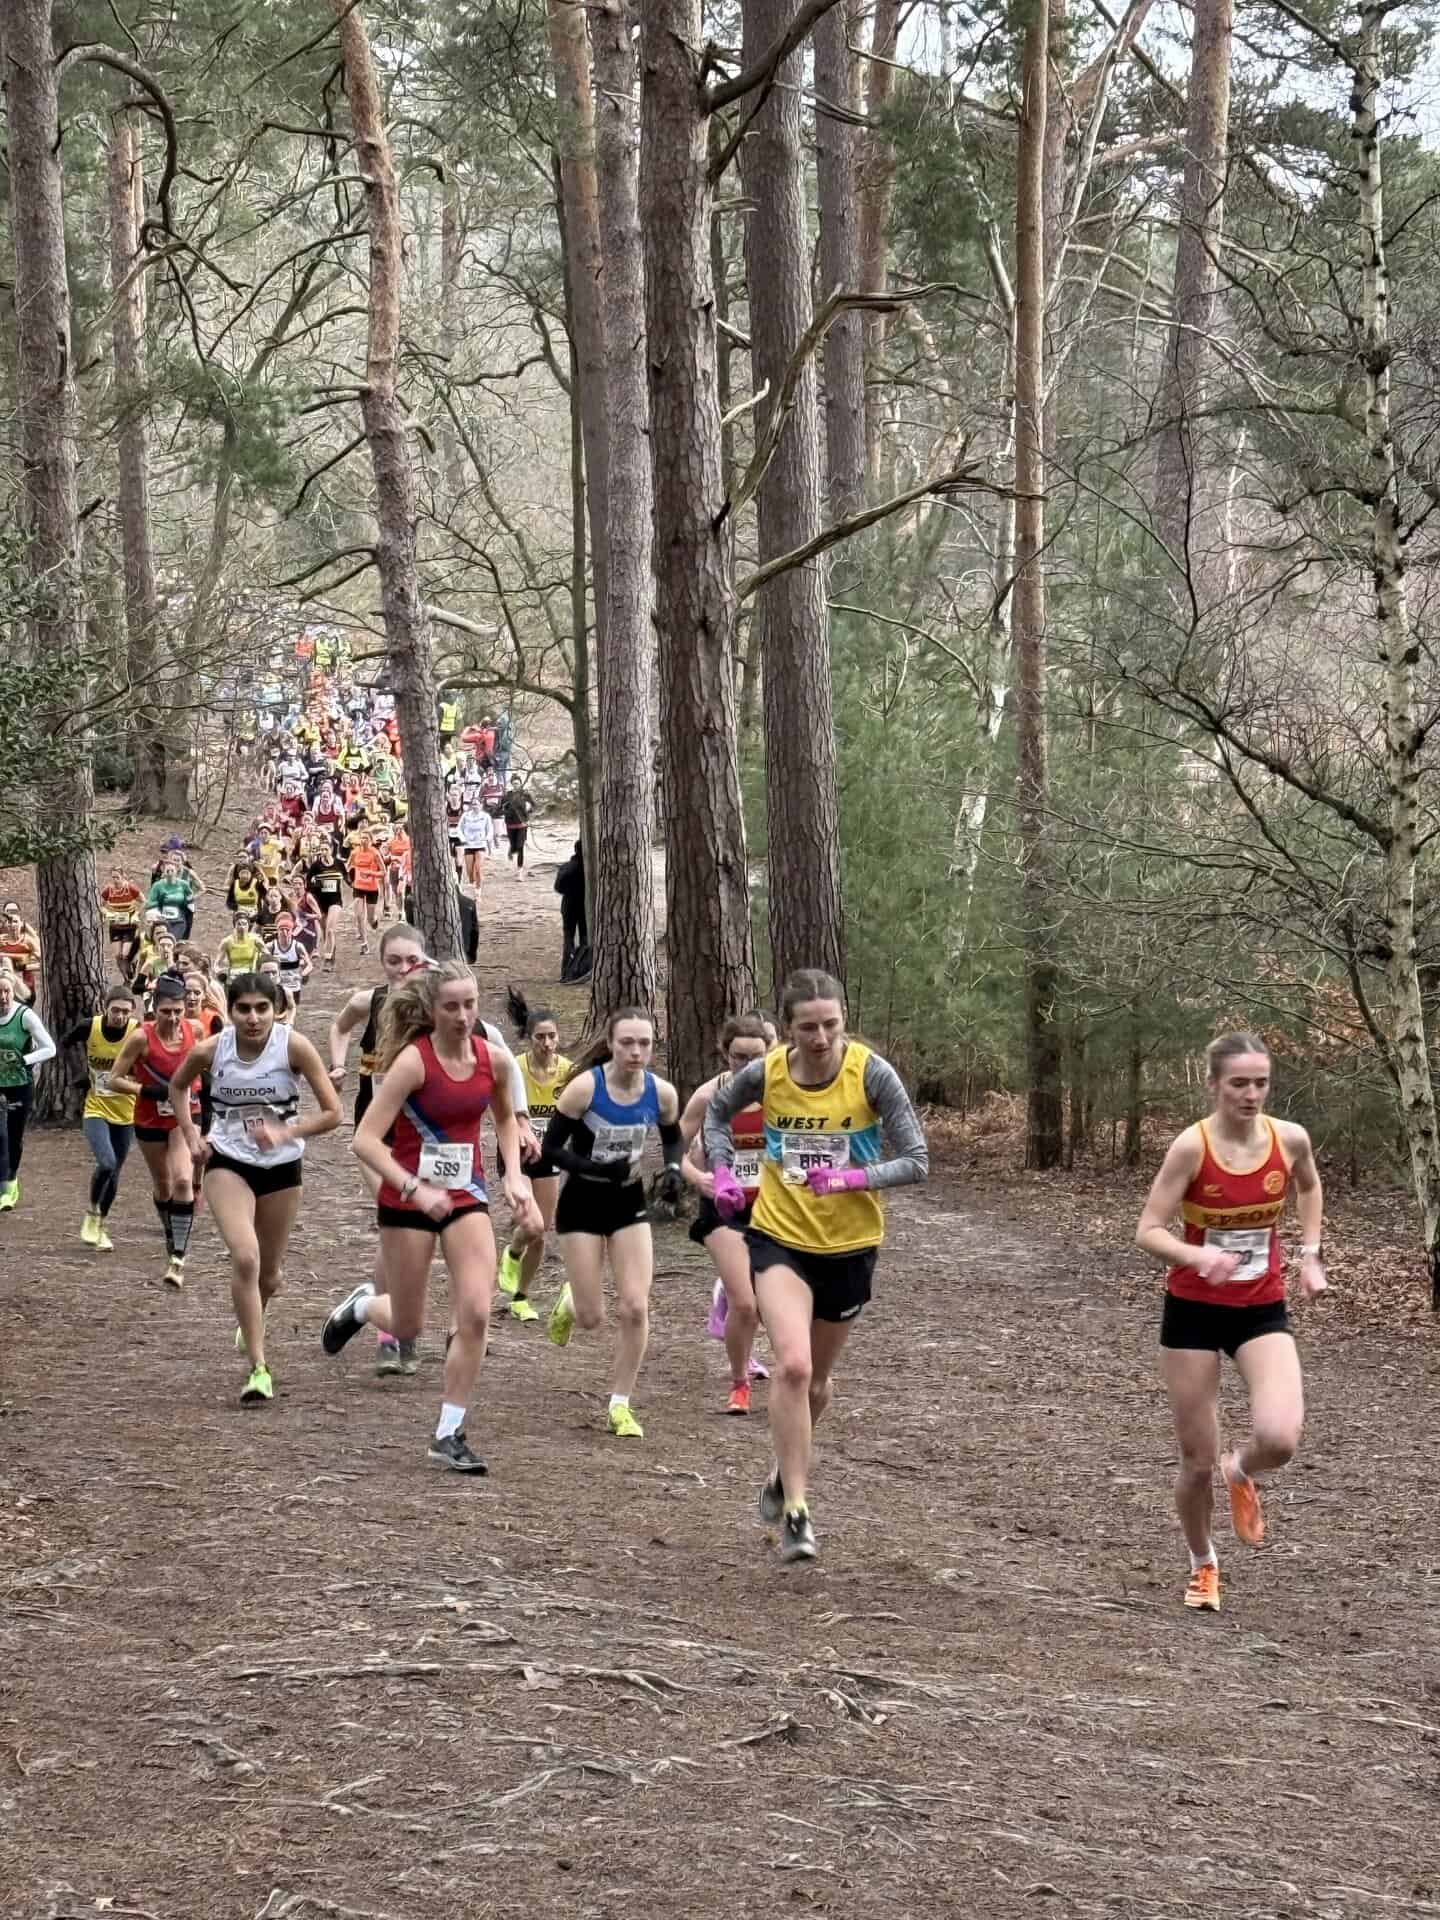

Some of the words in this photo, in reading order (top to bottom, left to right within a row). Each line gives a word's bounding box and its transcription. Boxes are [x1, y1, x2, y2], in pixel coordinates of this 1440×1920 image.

[776, 1116, 828, 1129] WEST
[841, 1116, 852, 1130] 4
[433, 1160, 460, 1177] 589
